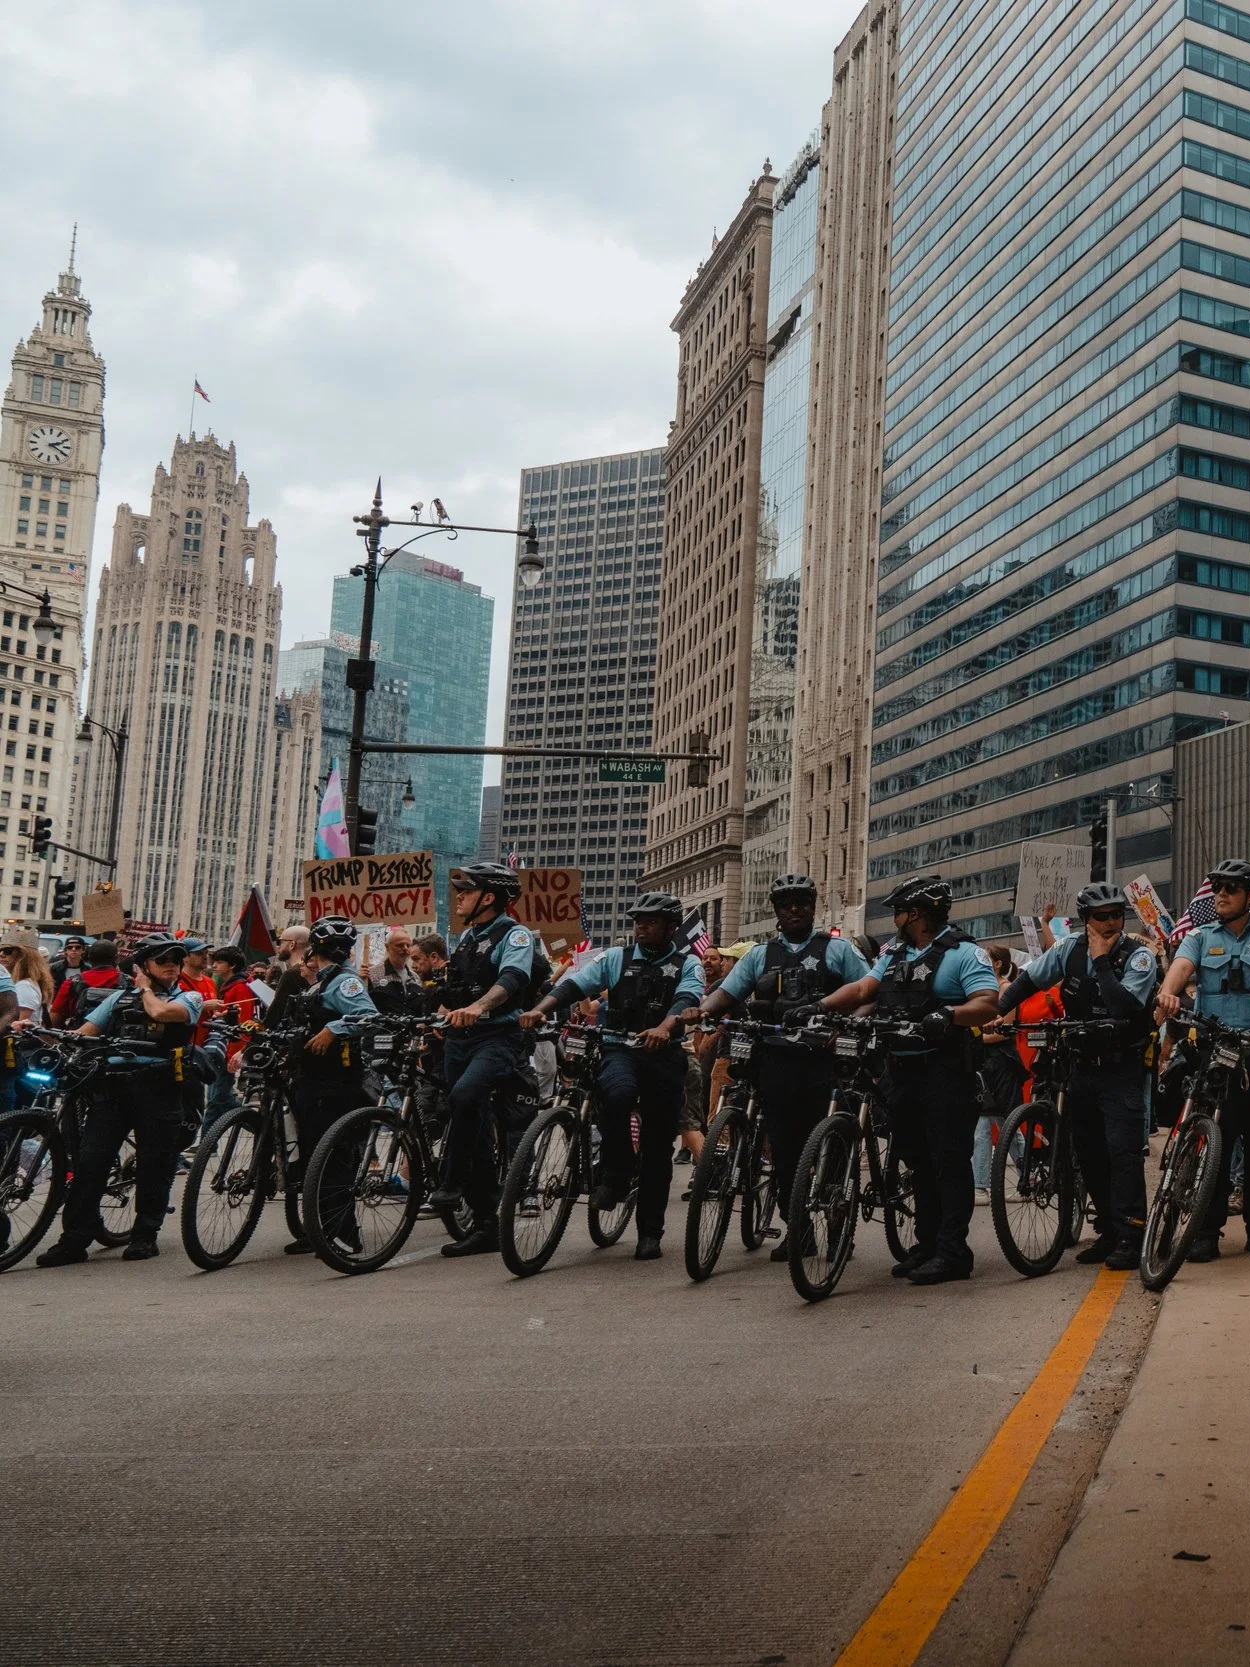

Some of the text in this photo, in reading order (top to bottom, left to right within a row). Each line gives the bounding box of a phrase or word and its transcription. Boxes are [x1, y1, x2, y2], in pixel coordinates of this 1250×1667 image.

[609, 762, 651, 773] WABASH
[652, 764, 662, 772] AV
[305, 853, 433, 892] TRUMP DESTROYS
[528, 870, 570, 892] NO
[310, 888, 432, 923] DEMOCRACY!
[505, 892, 581, 923] KINGS
